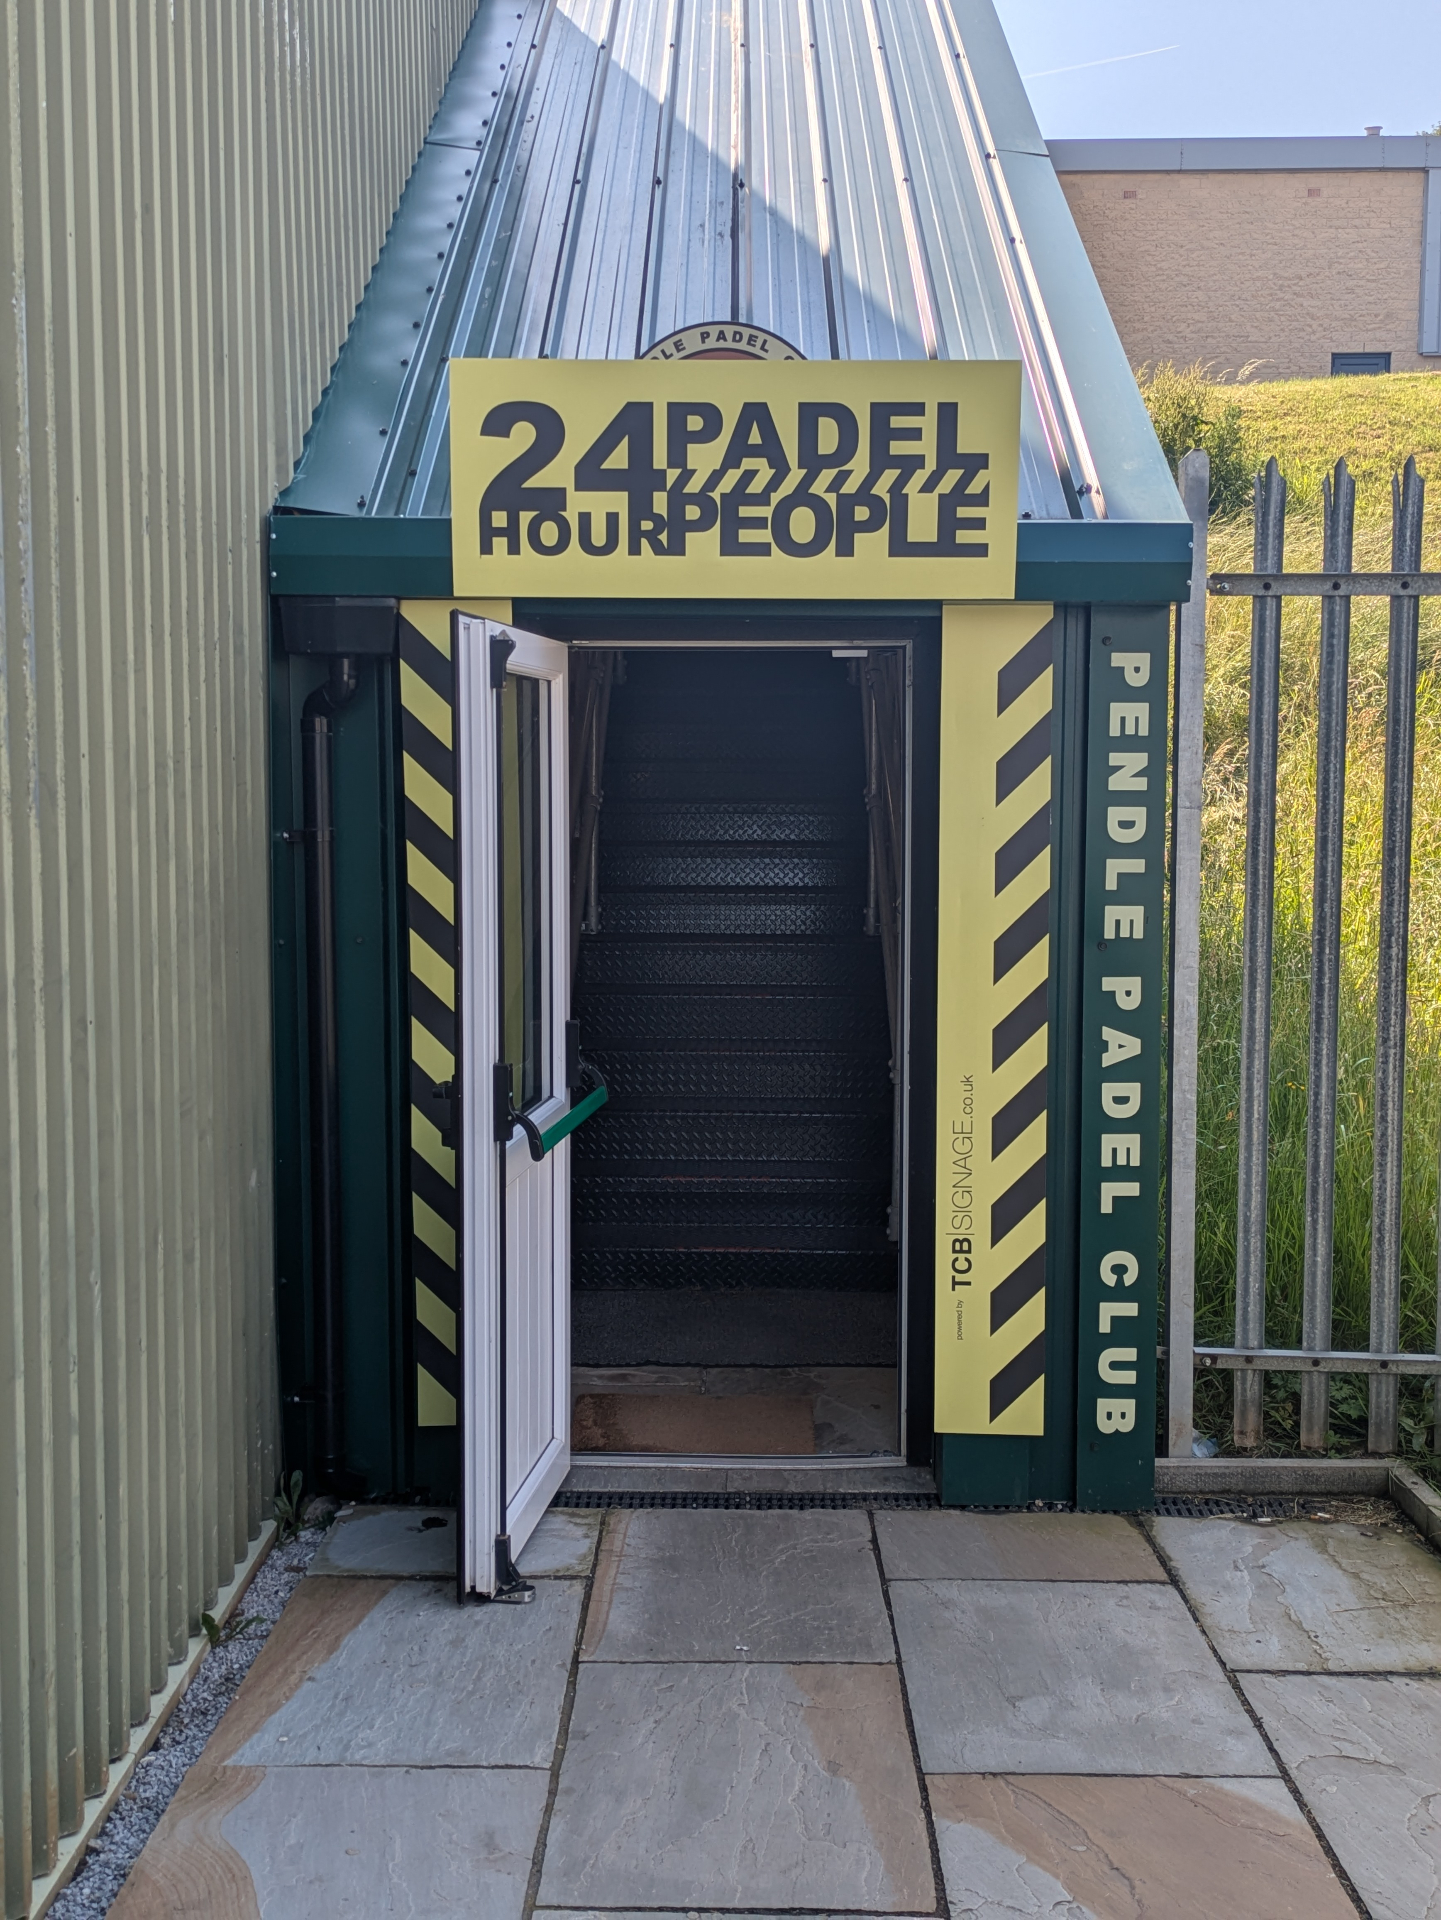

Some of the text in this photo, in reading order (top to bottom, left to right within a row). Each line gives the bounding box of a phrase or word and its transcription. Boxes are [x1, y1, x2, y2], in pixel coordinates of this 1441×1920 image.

[700, 329, 769, 353] PADEL
[479, 401, 668, 512] 24
[667, 401, 989, 470] PADEL
[479, 510, 668, 557] HOUR
[667, 492, 989, 558] PEOPLE
[1096, 652, 1151, 1435] PENDLE PADEL CLUB
[956, 1299, 964, 1309] by
[956, 1310, 964, 1341] powered
